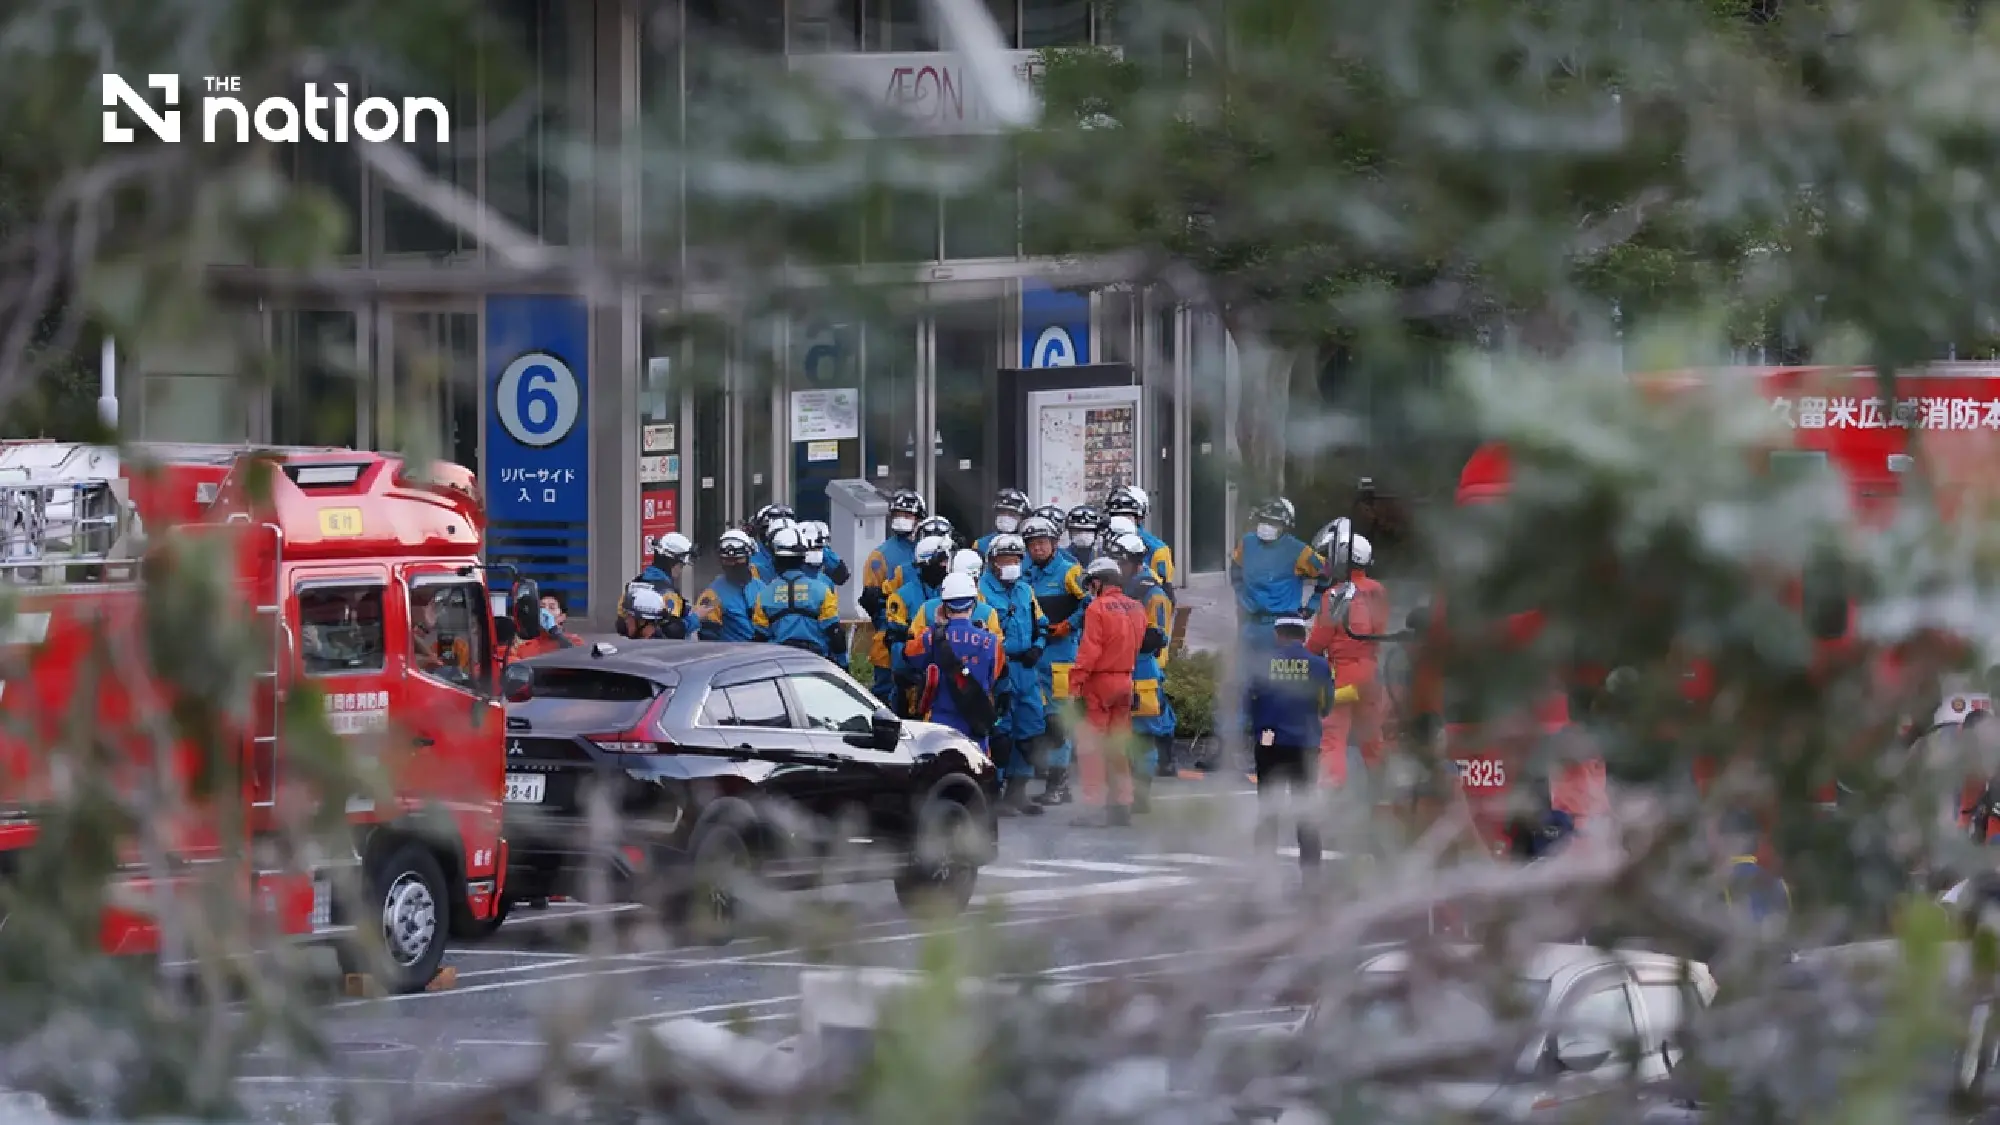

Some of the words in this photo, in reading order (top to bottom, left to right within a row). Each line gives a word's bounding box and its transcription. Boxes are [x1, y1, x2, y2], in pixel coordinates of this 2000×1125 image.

[517, 364, 558, 433] 6
[501, 468, 575, 483] リバーサイド
[1271, 658, 1309, 674] POLICE
